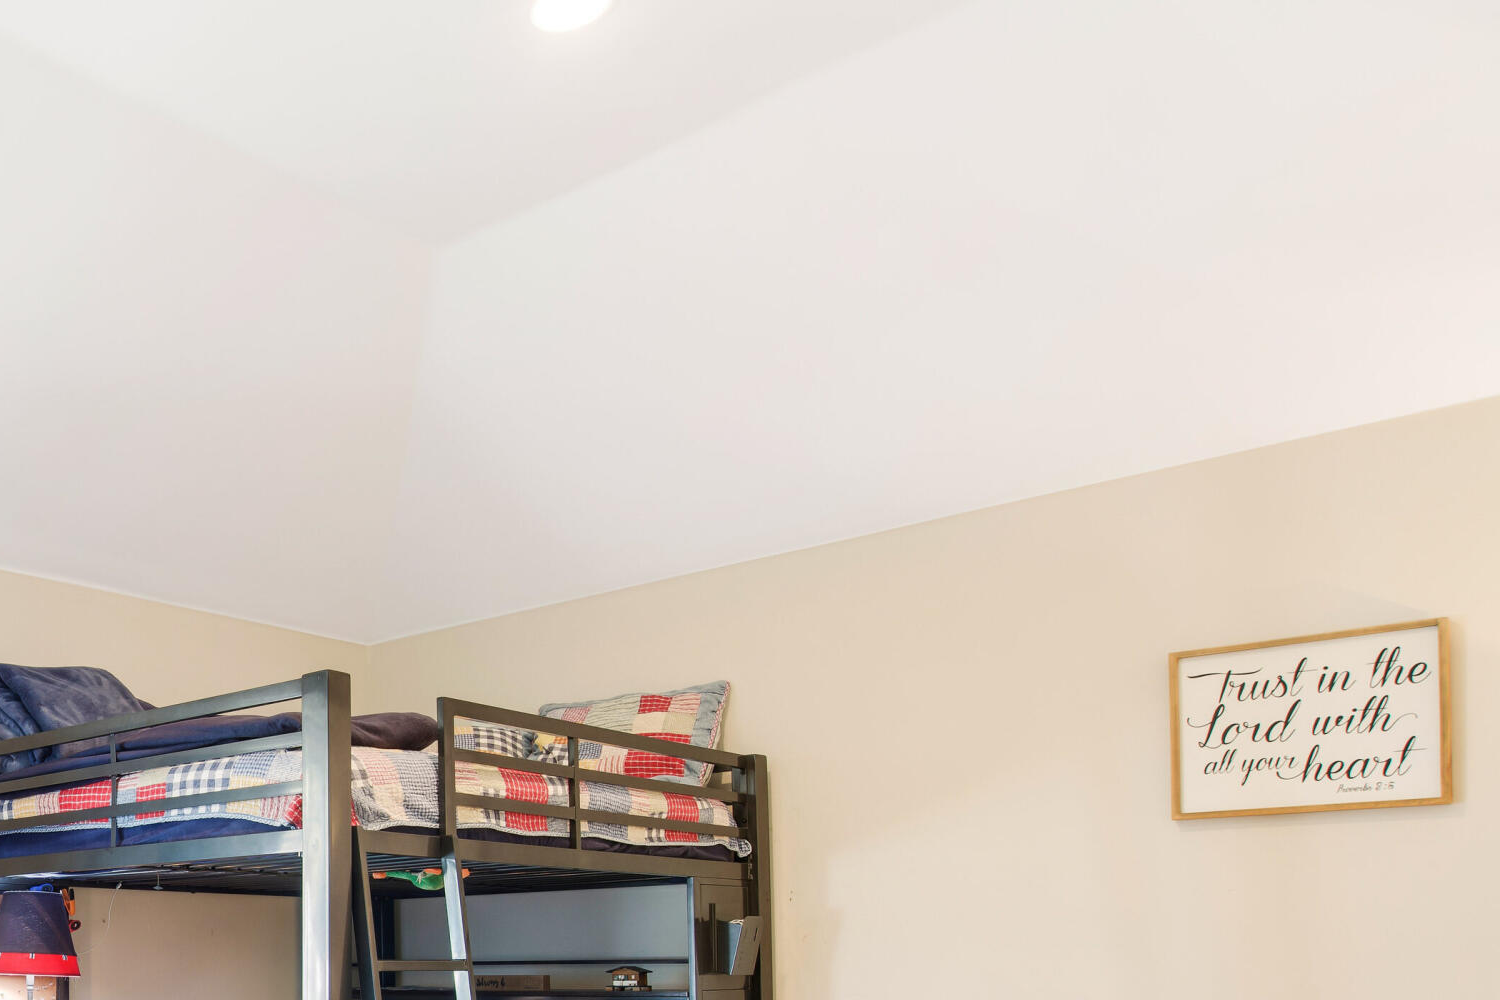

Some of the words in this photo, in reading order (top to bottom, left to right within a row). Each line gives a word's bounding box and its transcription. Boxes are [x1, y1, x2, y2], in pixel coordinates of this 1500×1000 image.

[1187, 657, 1316, 703] Trust
[1317, 666, 1356, 694] in
[1367, 646, 1432, 688] the
[1187, 699, 1302, 749] Lord
[1312, 695, 1418, 735] with
[1204, 749, 1236, 775] all
[1242, 755, 1296, 786] your
[1277, 735, 1428, 783] heart
